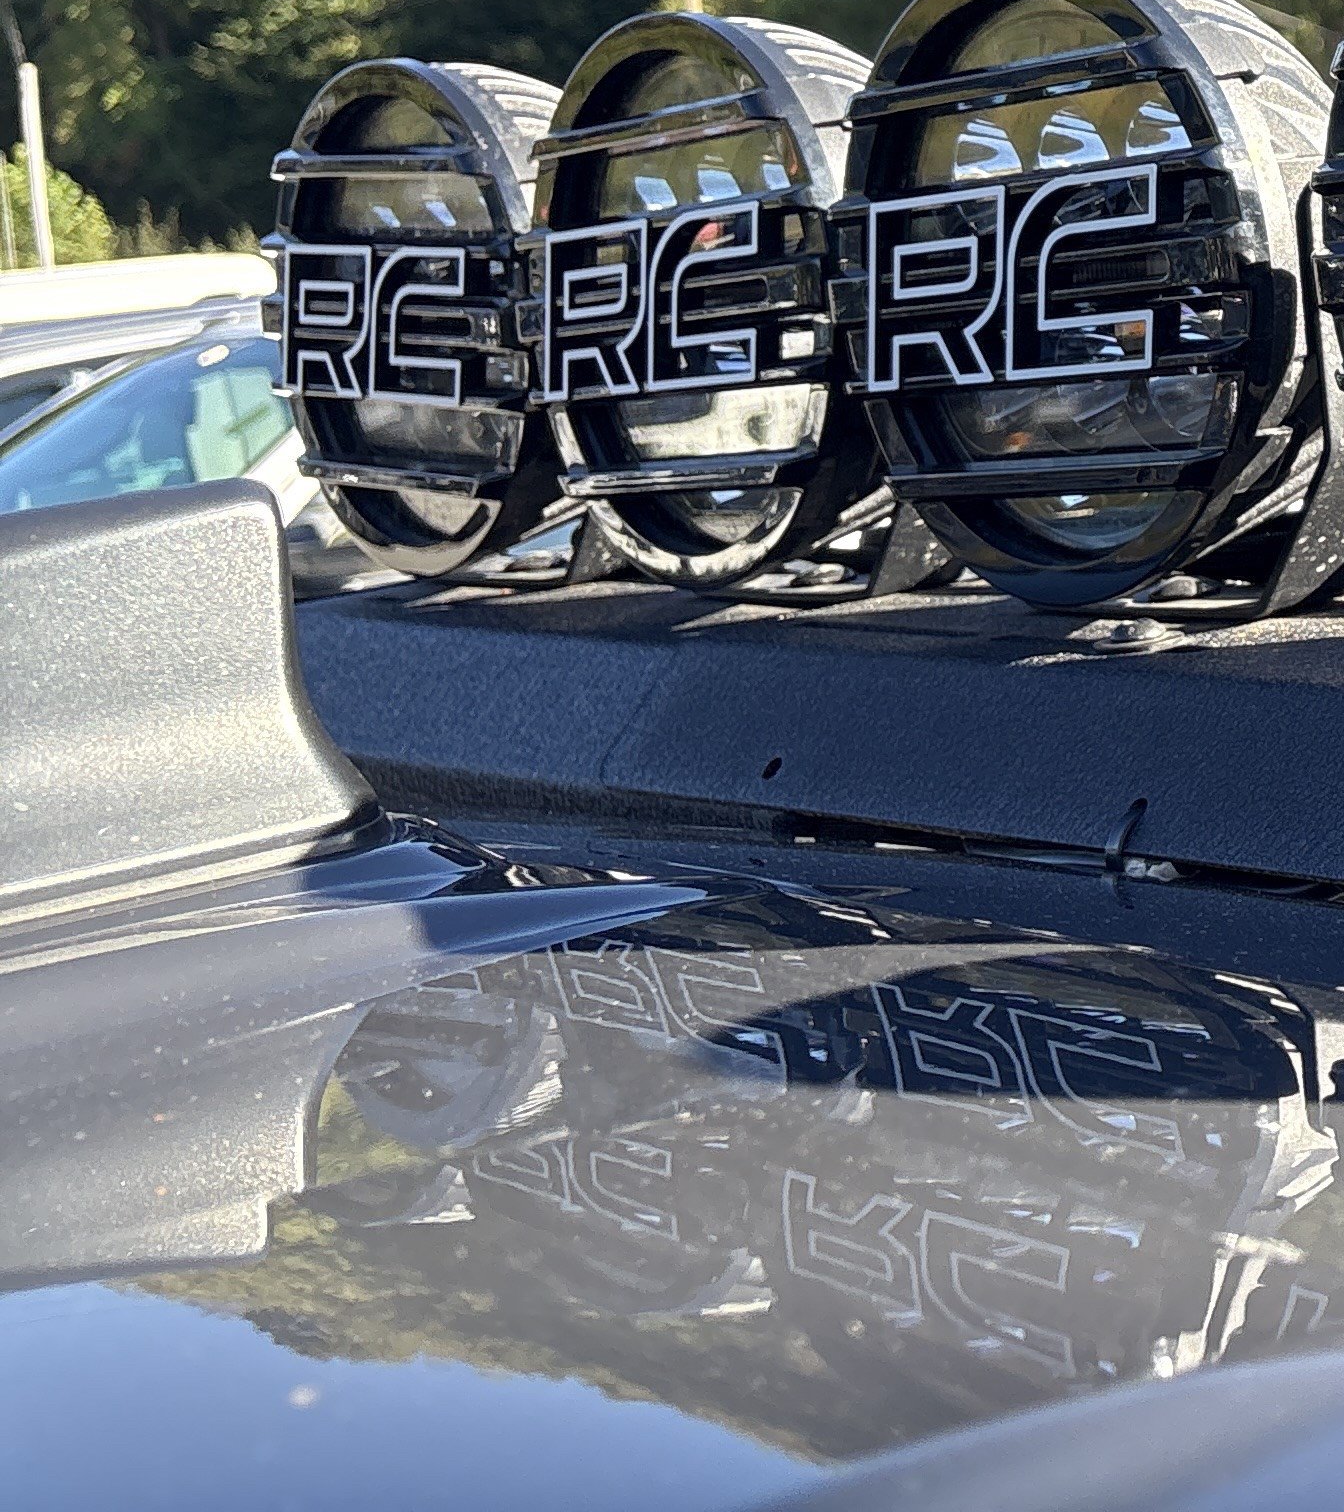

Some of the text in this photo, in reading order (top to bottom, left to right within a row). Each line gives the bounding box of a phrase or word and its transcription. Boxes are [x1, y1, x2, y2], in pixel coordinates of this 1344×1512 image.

[283, 243, 465, 406] RC
[544, 201, 759, 402] RC
[868, 163, 1157, 392] RC
